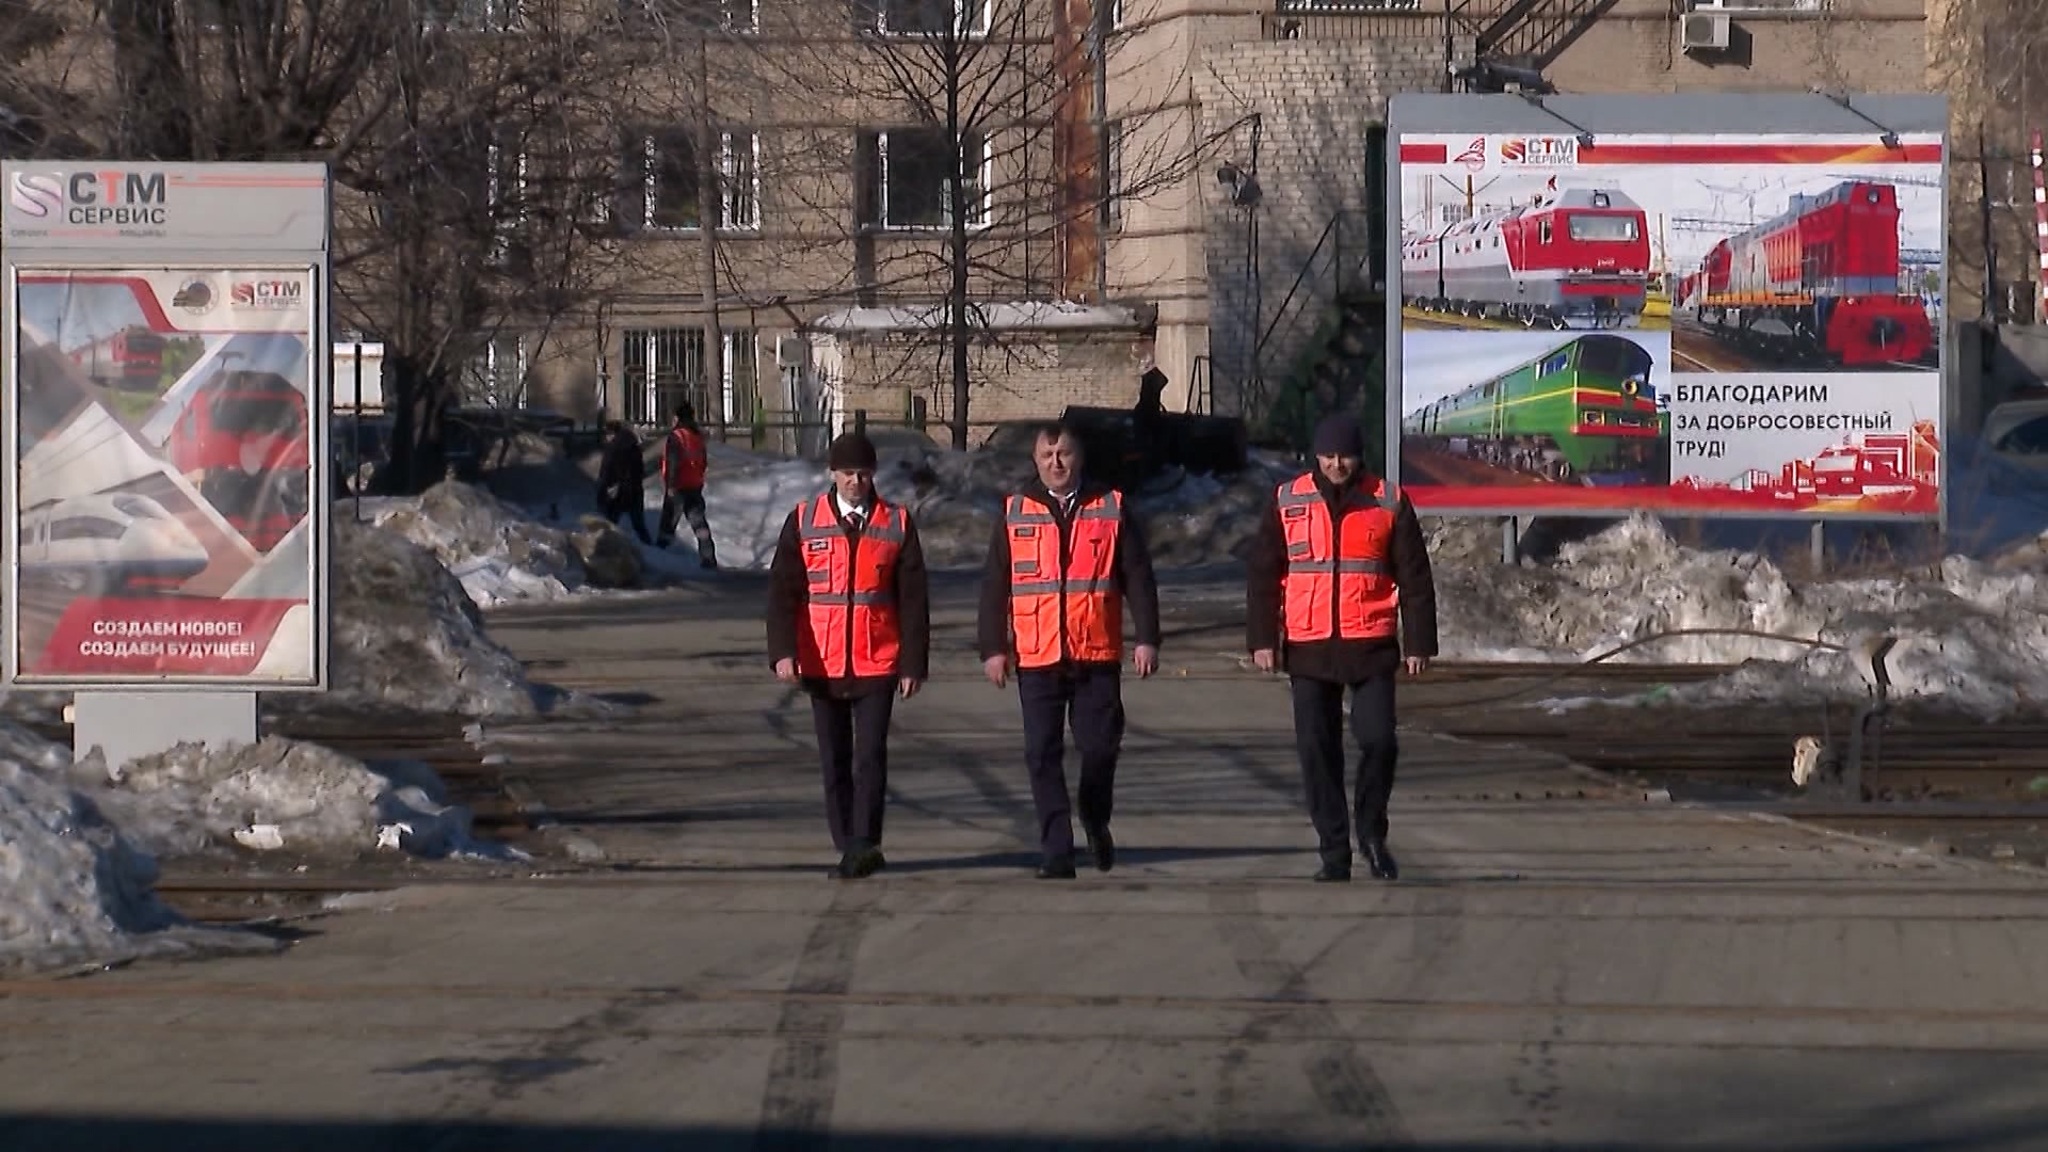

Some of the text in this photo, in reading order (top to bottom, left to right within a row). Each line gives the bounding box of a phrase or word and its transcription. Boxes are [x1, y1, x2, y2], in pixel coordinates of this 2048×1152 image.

[1528, 138, 1574, 154] СТМ
[69, 171, 166, 205] СТМ
[69, 207, 166, 224] СЕРВИС
[257, 281, 301, 296] СТМ
[1677, 385, 1828, 404] БЛАГОДАРИМ
[1677, 411, 1892, 430] ЗА ДОБРОСОВЕСТНЫЙ
[1676, 441, 1725, 457] ТРУД!
[93, 621, 242, 637] СОЗДАЕМ НОВОЕ!
[80, 641, 256, 658] СОЗДАЕМ БУДУЩЕЕ!
